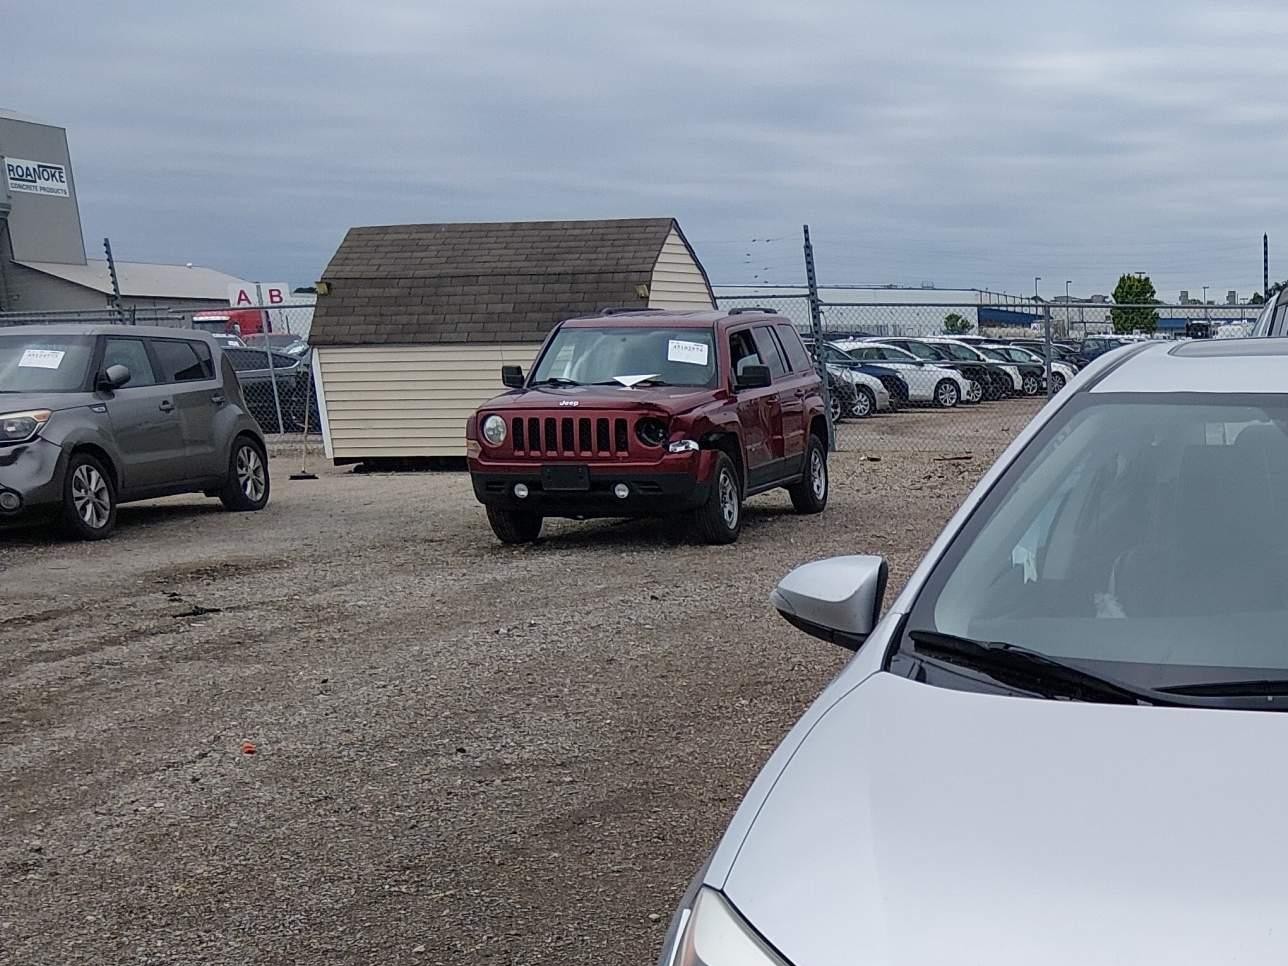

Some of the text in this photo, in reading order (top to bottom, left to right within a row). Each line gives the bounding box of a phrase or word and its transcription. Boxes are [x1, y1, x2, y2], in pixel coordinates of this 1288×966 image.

[7, 163, 66, 183] ROANOKE
[237, 289, 284, 305] A B
